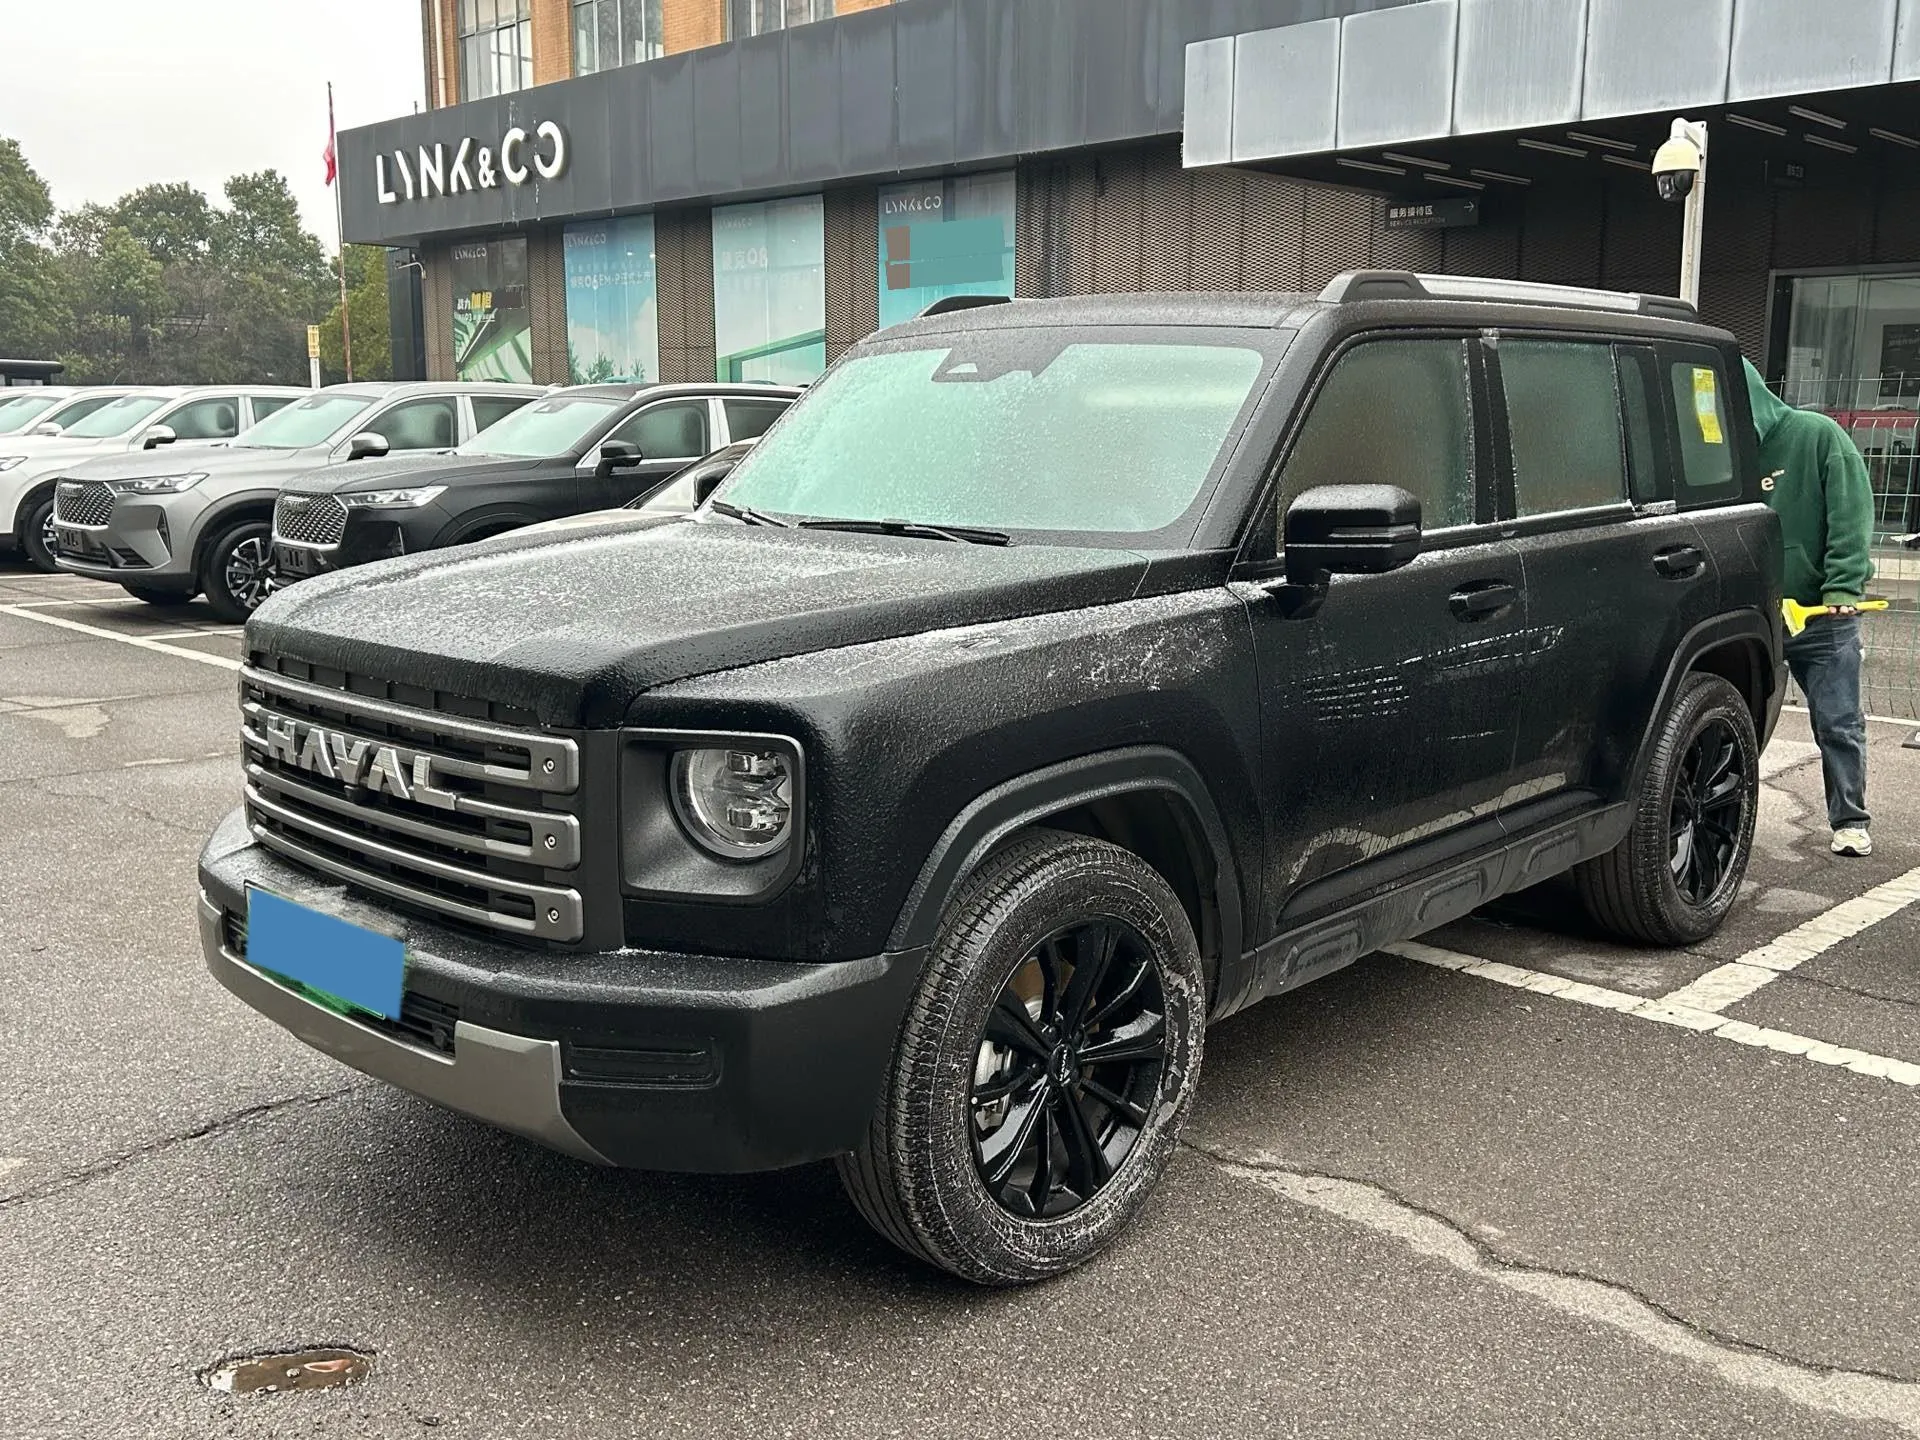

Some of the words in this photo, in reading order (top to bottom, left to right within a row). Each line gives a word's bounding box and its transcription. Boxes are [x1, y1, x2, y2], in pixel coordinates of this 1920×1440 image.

[376, 121, 567, 204] LYNK&CO
[886, 196, 942, 214] LYNK&CO
[1389, 205, 1433, 218] 服务接待区
[265, 714, 458, 811] HAVAL
